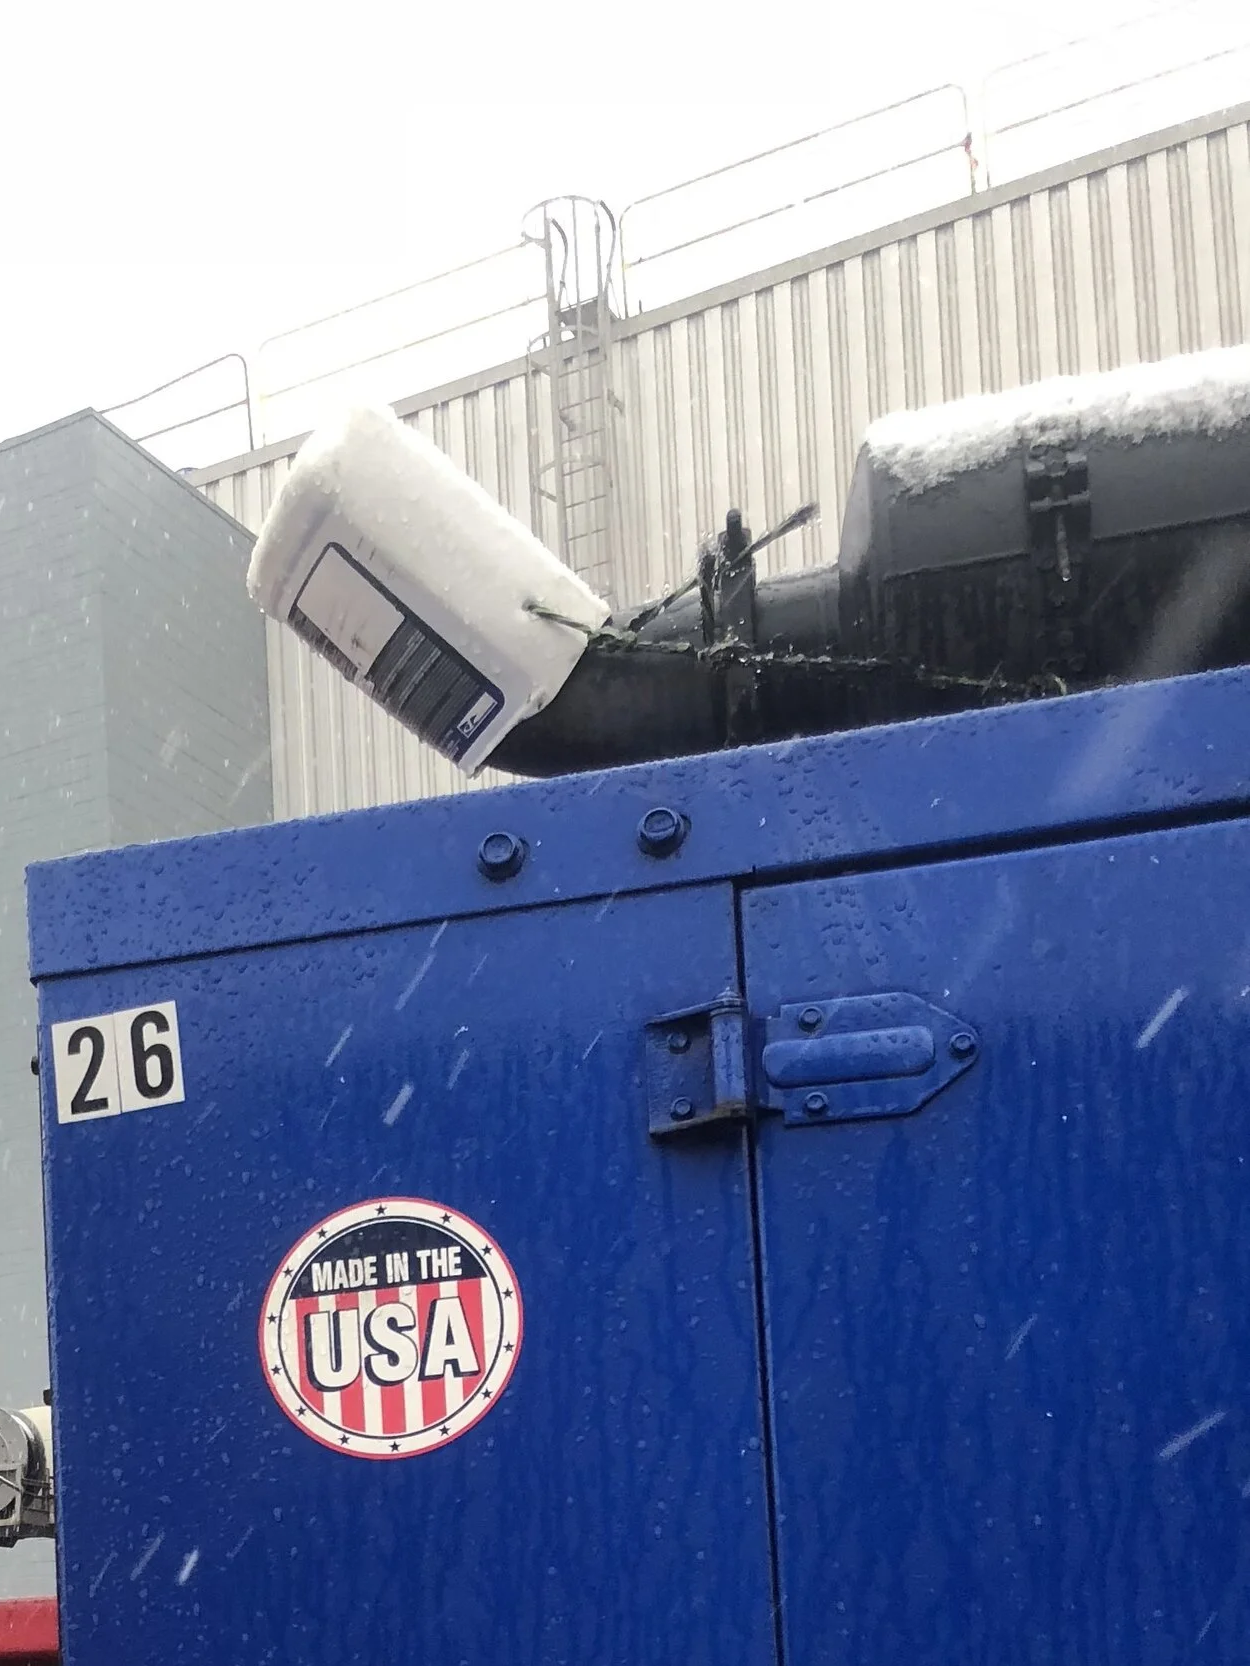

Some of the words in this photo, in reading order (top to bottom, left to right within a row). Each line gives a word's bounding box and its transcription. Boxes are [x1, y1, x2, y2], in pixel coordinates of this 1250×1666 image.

[67, 1010, 176, 1115] 26
[311, 1255, 378, 1293] MADE
[385, 1251, 410, 1284] IN
[416, 1245, 463, 1280] THE
[304, 1296, 481, 1392] USA
